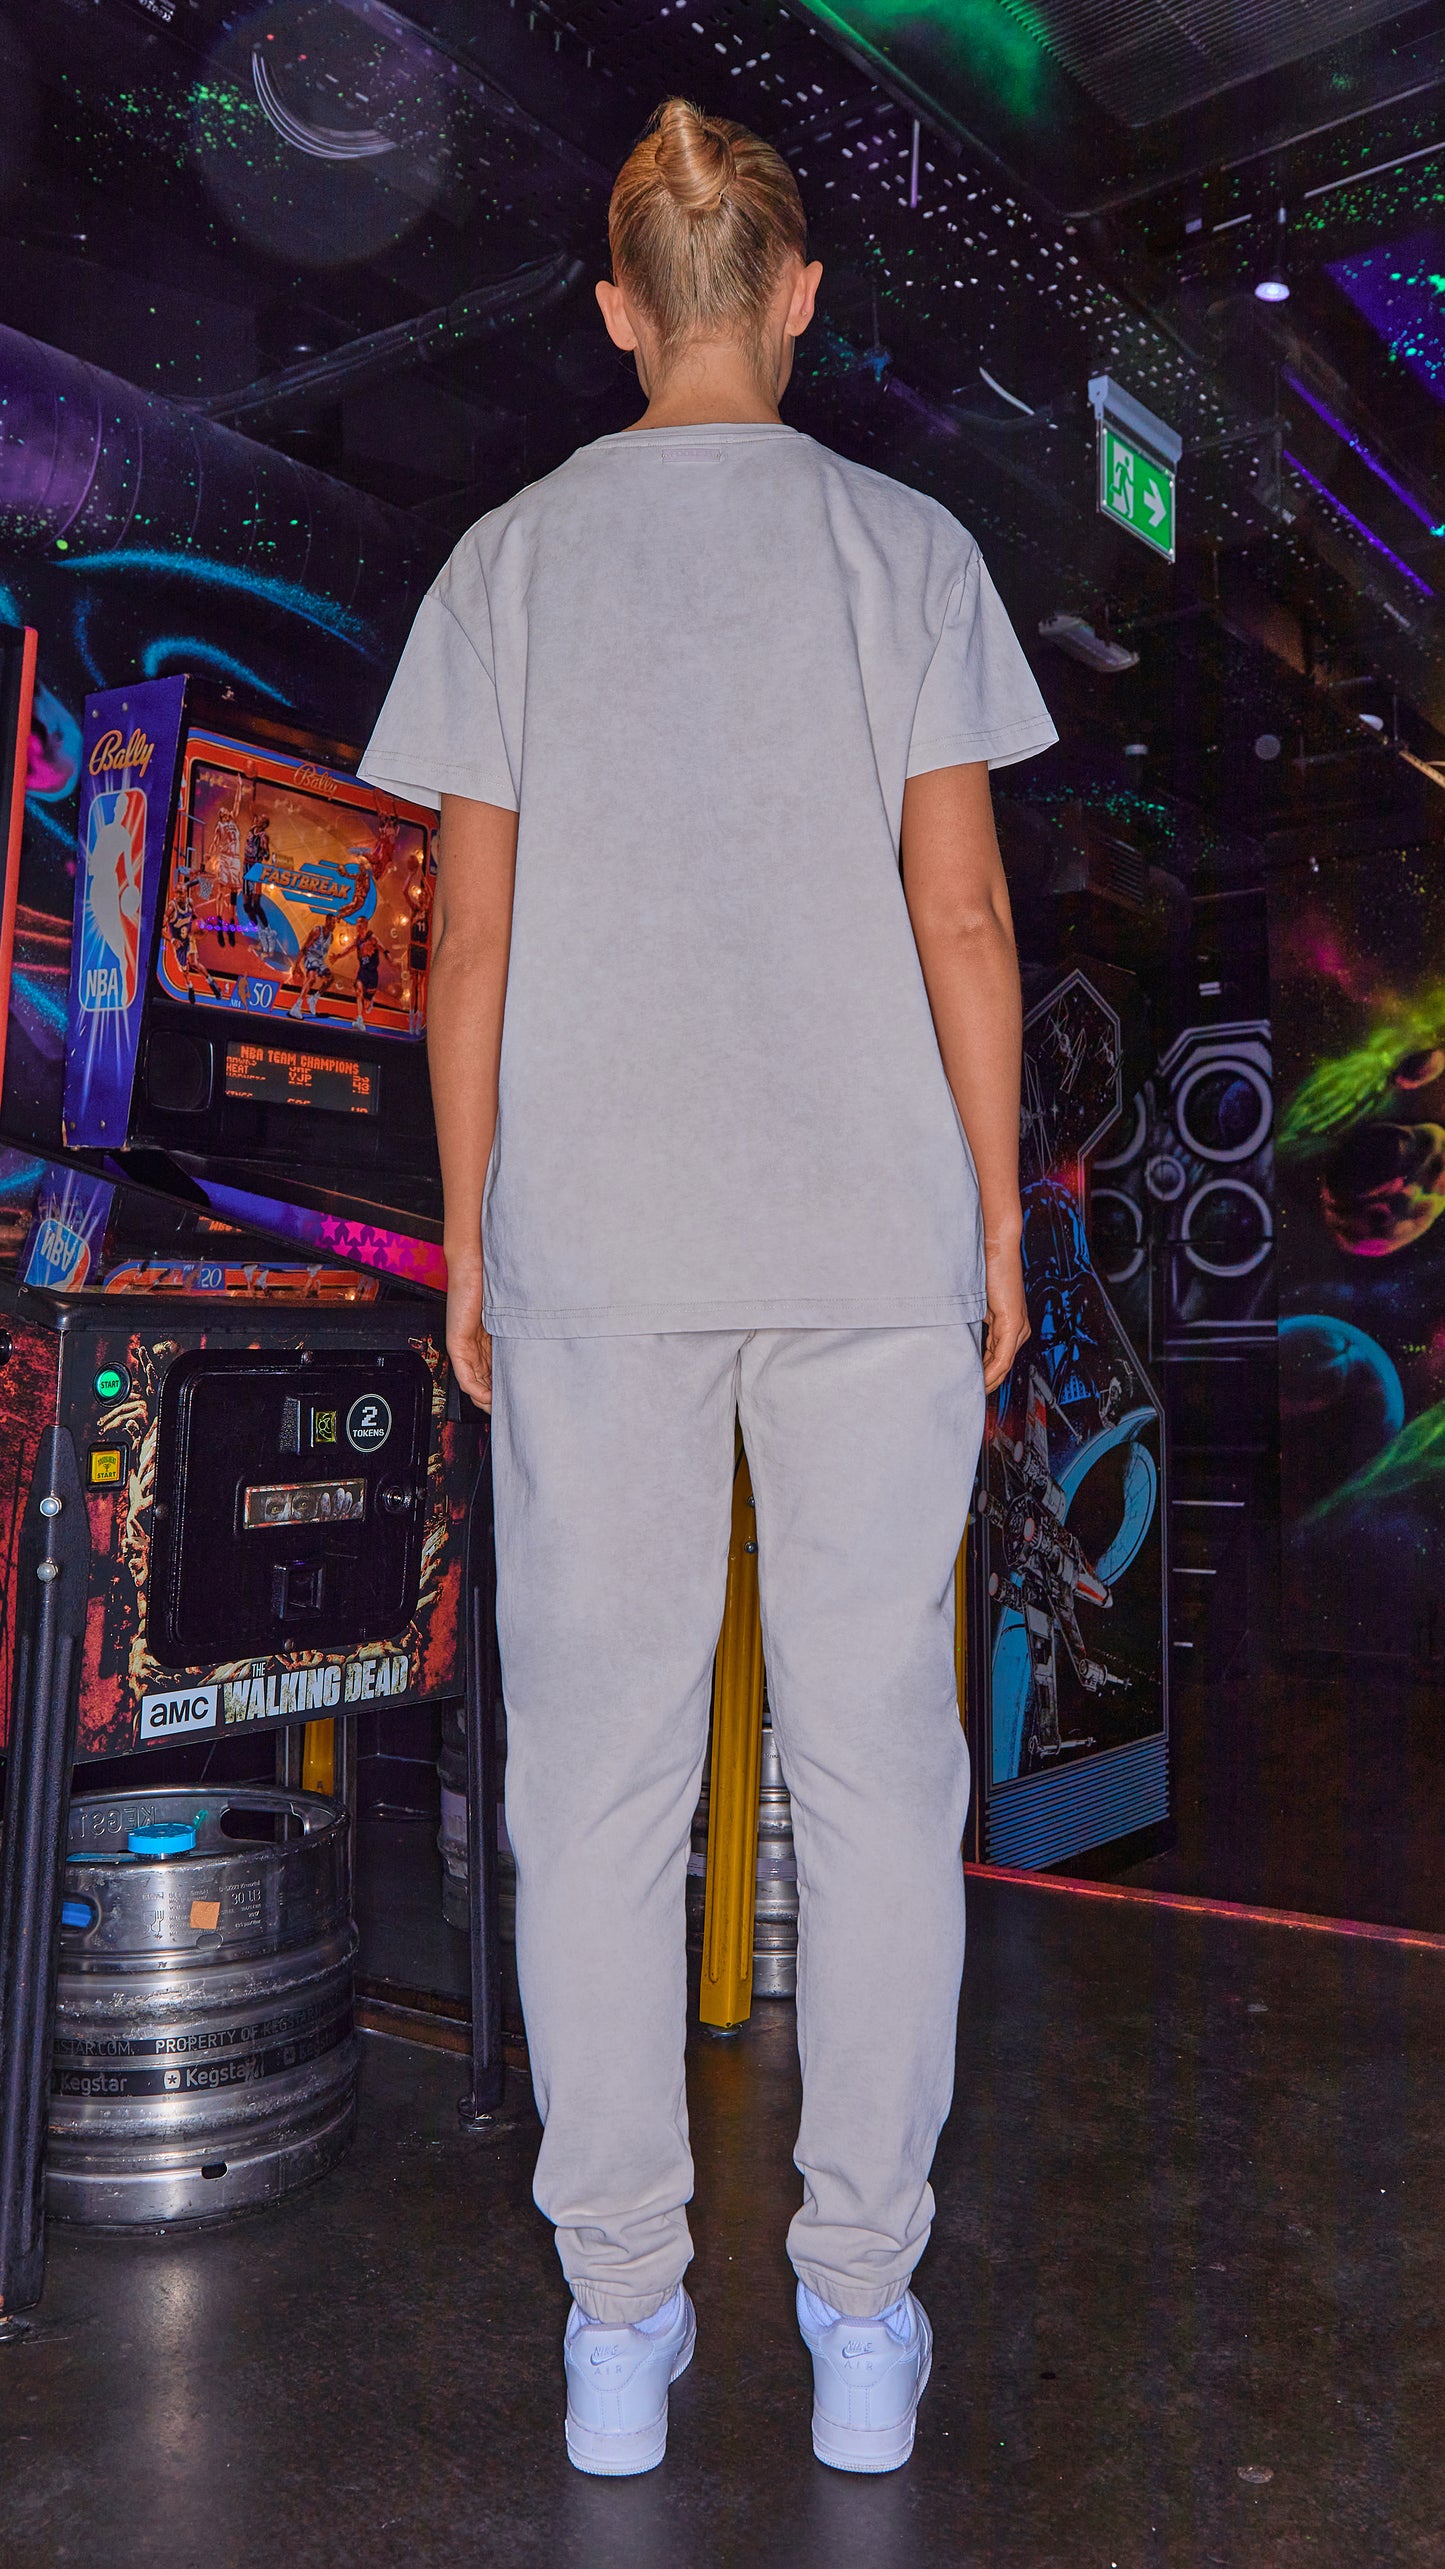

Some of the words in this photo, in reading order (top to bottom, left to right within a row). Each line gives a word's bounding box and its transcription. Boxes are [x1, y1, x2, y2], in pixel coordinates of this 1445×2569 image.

[89, 728, 155, 778] Bally
[293, 763, 338, 801] Bally
[87, 967, 119, 998] NBA
[249, 982, 273, 1008] 50
[225, 1062, 249, 1074] HEAT
[240, 1045, 264, 1061] NBA
[267, 1050, 297, 1066] TEAM
[300, 1055, 360, 1076] CHAMPIONS
[101, 1380, 119, 1389] START
[361, 1406, 378, 1427] 2
[353, 1428, 385, 1438] TOKENS
[97, 1471, 116, 1479] START
[252, 1662, 266, 1677] THE
[223, 1664, 341, 1725] WALKING
[344, 1655, 409, 1703] DEAD
[155, 2028, 237, 2054] PROPERTY
[61, 2072, 128, 2096] Kegstar
